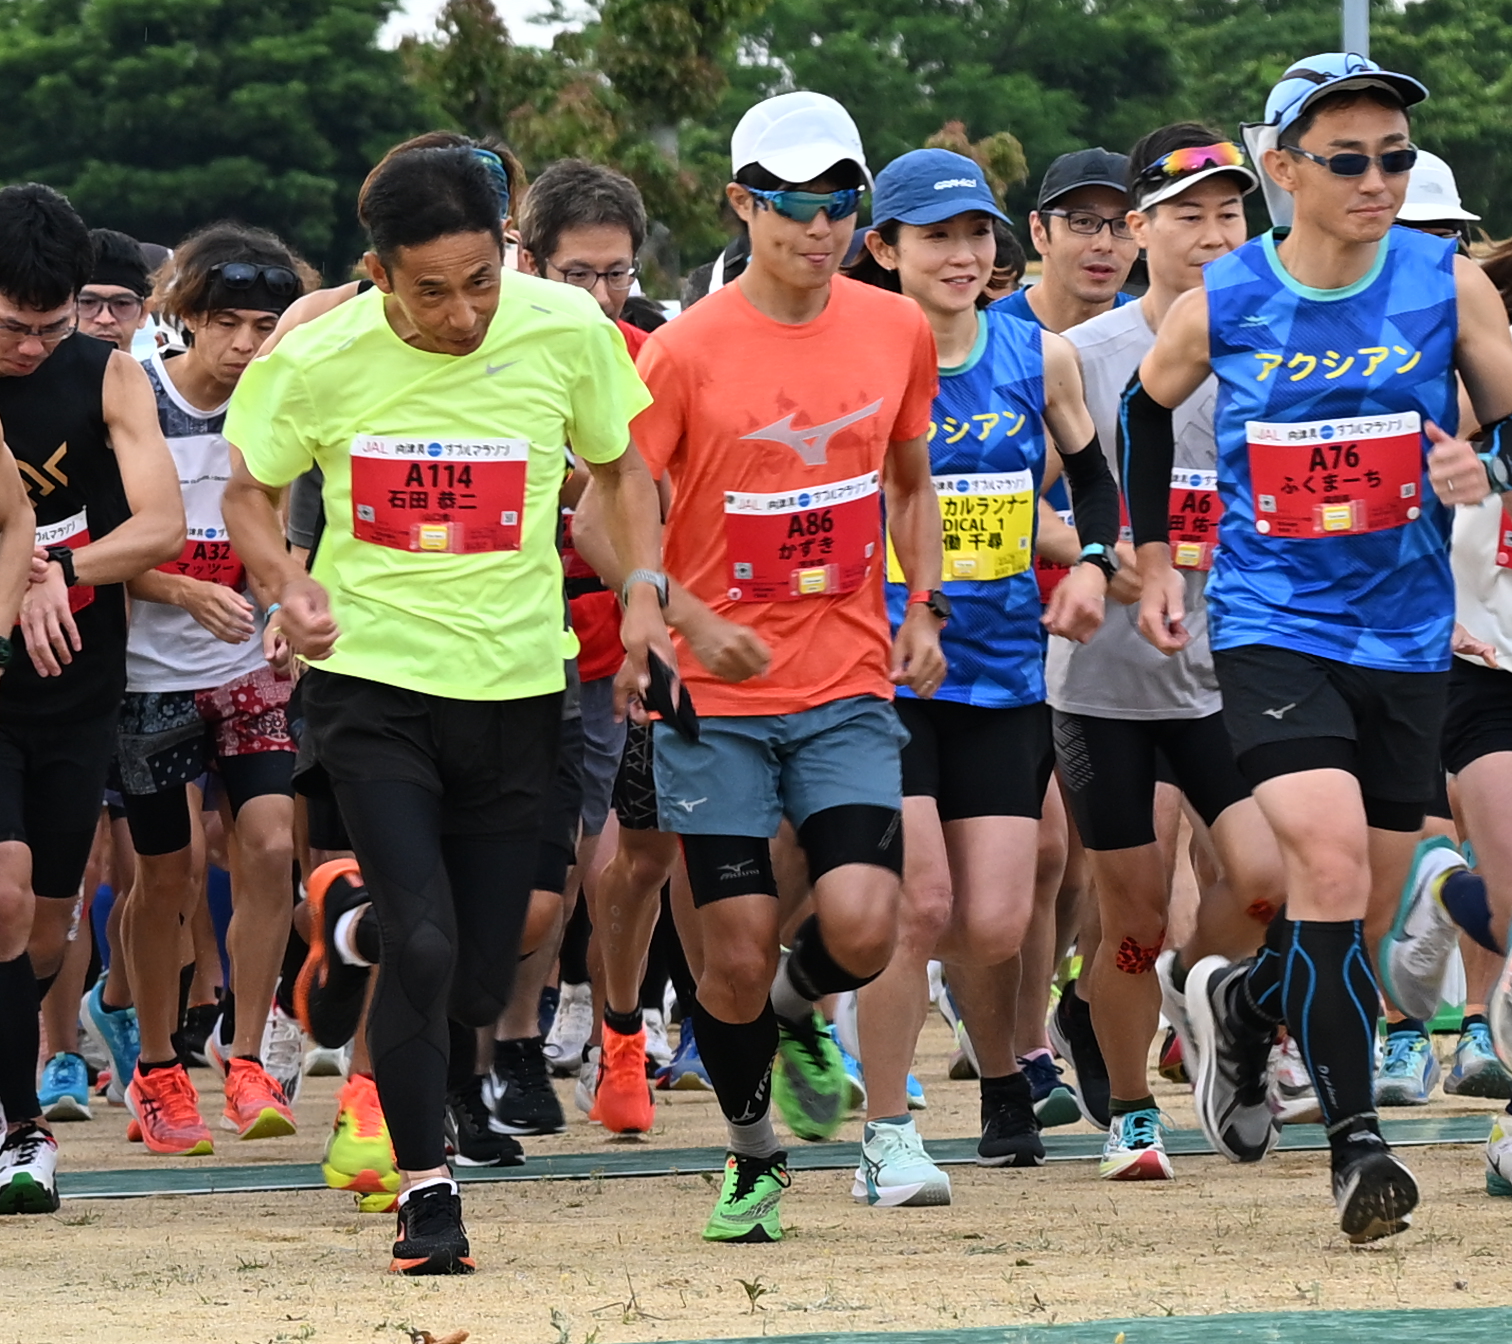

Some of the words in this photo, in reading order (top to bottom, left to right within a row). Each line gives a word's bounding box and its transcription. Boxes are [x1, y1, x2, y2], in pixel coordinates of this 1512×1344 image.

[1254, 345, 1422, 382] アクシアン
[1309, 444, 1360, 473] A76
[405, 463, 473, 488] A114
[1281, 469, 1382, 494] ふくまーち
[388, 490, 429, 510] 石田
[437, 490, 478, 510] 恭二
[944, 495, 1029, 516] カルランナー
[1181, 492, 1212, 513] A6
[35, 519, 77, 543] ブルマラソン
[788, 510, 834, 539] A86
[943, 518, 989, 533] DICAL
[997, 517, 1005, 531] 1
[193, 542, 230, 561] A32
[778, 536, 834, 560] かずき
[968, 533, 1003, 551] 千尋
